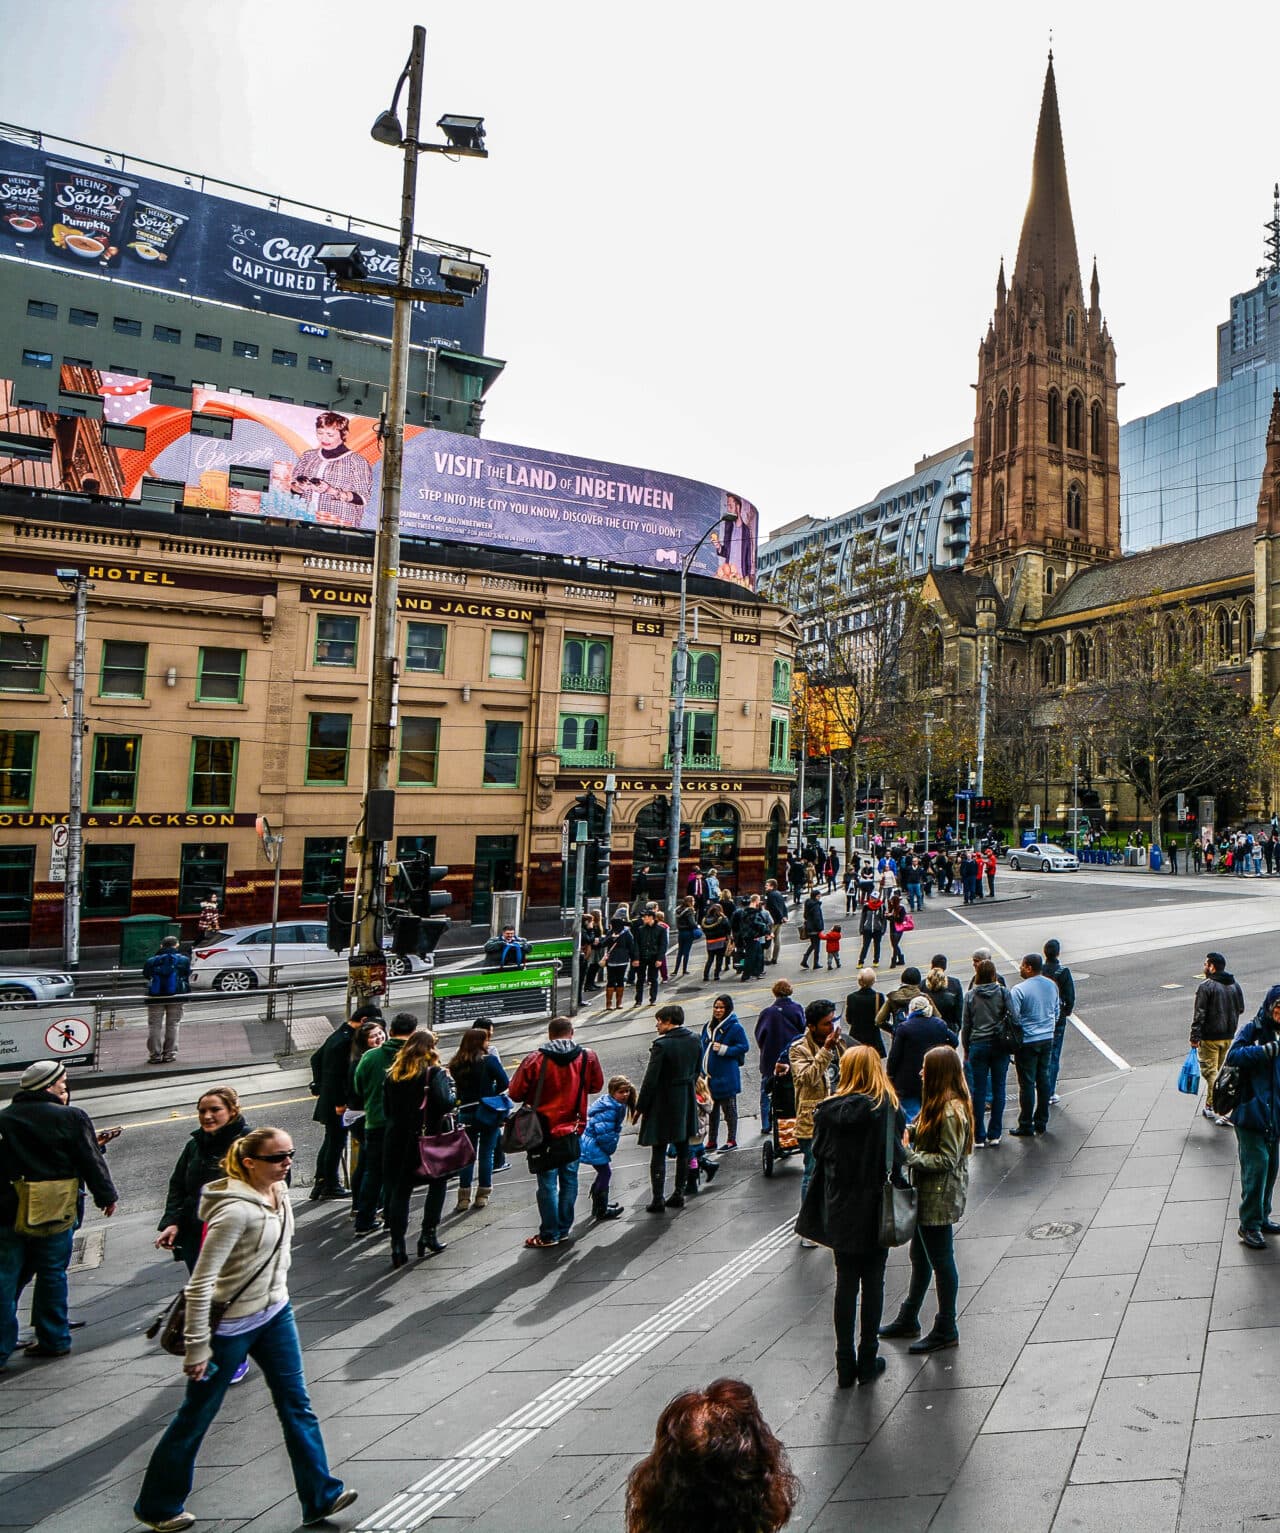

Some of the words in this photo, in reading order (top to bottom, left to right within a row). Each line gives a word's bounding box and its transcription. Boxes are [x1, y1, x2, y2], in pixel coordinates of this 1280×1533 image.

[75, 178, 108, 193] HEINZ
[62, 213, 111, 233] Pumpkin
[262, 237, 323, 269] Caf
[232, 256, 316, 291] CAPTURED
[302, 325, 326, 336] APN
[434, 452, 484, 480] VISIT
[487, 464, 506, 479] THE
[505, 464, 557, 491] LAND
[560, 478, 573, 490] OF
[575, 475, 674, 511] INBETWEEN
[419, 489, 442, 501] STEP
[444, 492, 467, 506] INTO
[468, 495, 486, 509] THE
[488, 499, 507, 512] CITY
[509, 502, 529, 515] YOU
[530, 505, 561, 522] KNOW,
[563, 511, 603, 527] DISCOVER
[605, 517, 621, 529] THE
[622, 519, 640, 532] CITY
[641, 522, 658, 535] YOU
[659, 525, 682, 539] DON'T
[89, 566, 176, 585] HOTEL
[439, 600, 533, 621] JACKSON
[733, 633, 757, 643] 1875
[87, 817, 99, 826] &
[109, 814, 235, 827] JACKSON
